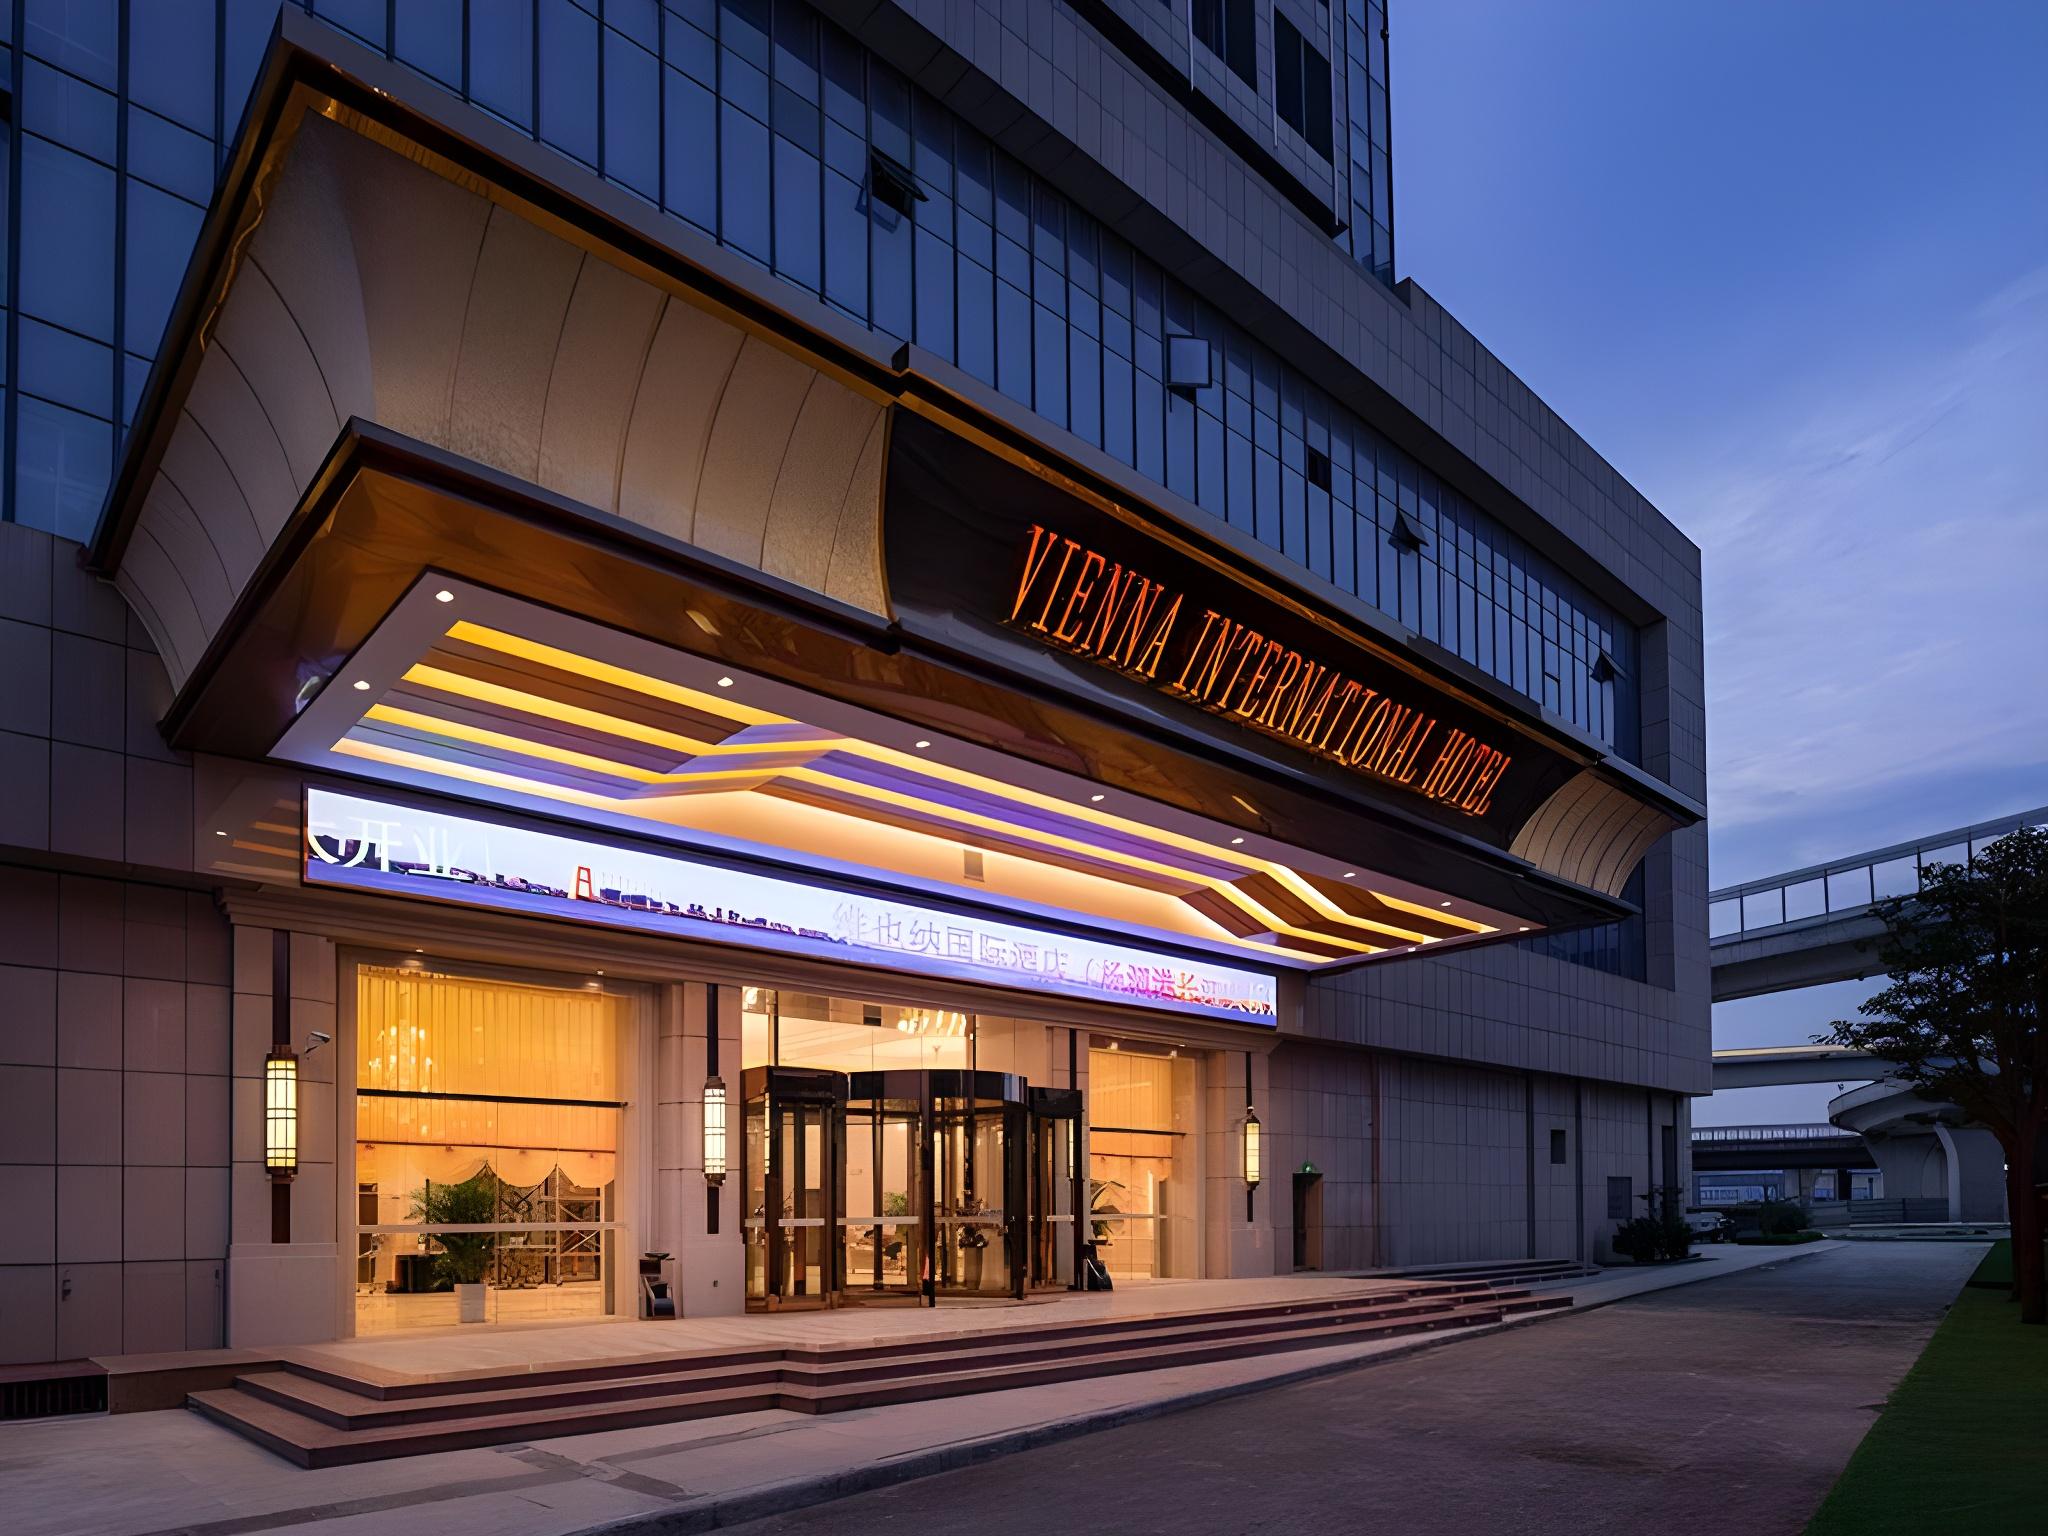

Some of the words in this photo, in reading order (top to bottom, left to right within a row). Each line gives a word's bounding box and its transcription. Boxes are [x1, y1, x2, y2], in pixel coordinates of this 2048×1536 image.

[1010, 523, 1184, 679] VIENNA
[1172, 608, 1437, 786] INTERNATIONAL
[1422, 726, 1512, 817] HOTEL
